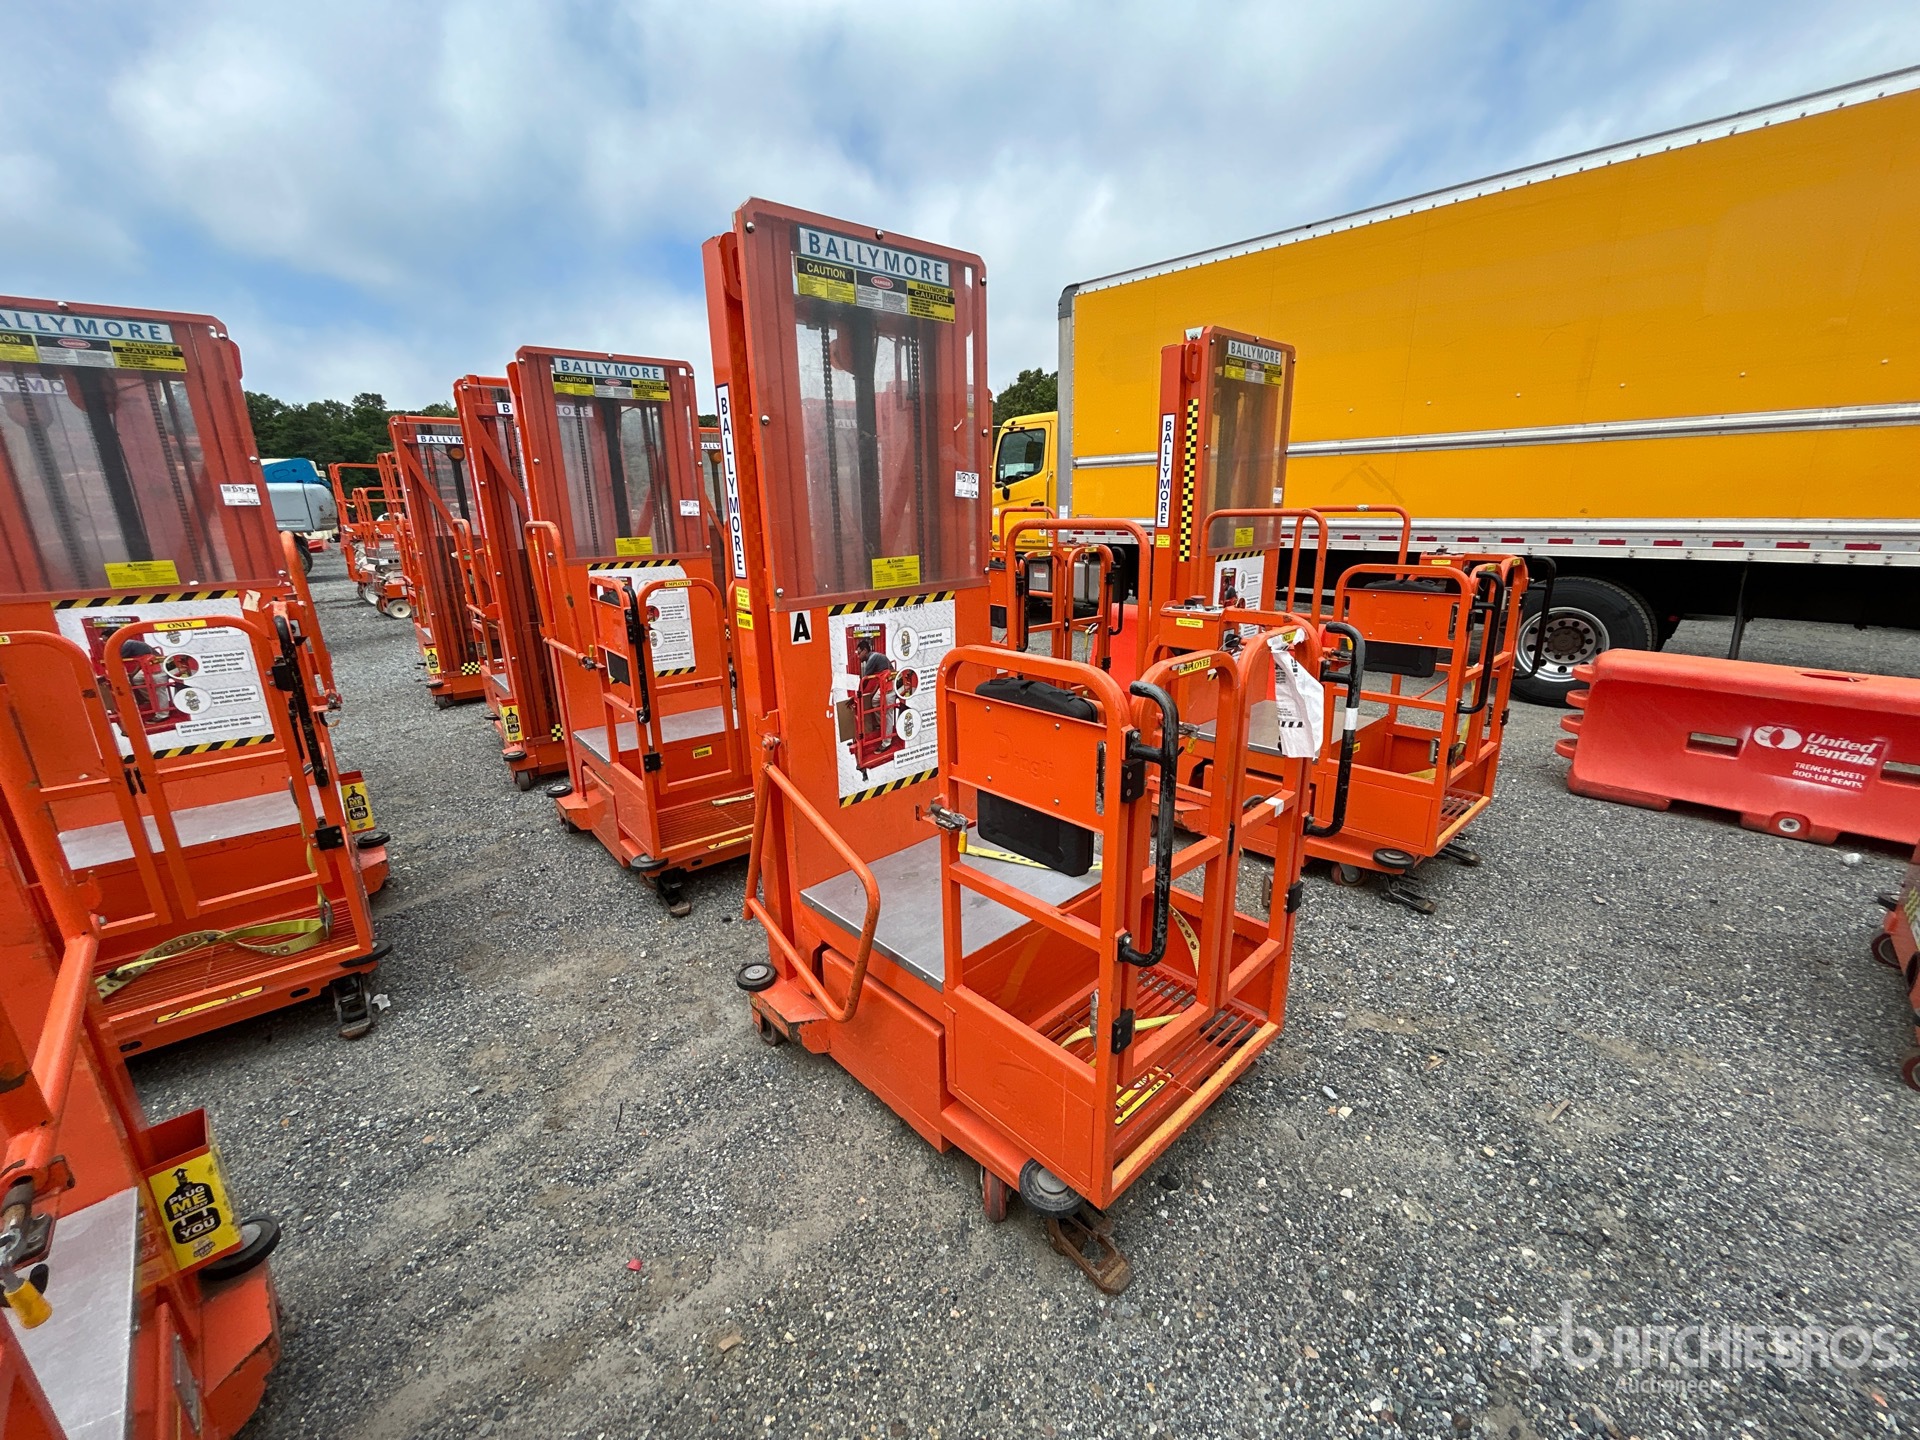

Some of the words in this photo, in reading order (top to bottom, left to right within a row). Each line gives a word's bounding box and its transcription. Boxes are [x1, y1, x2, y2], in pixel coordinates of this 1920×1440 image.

[808, 232, 943, 283] BALLYMORE
[806, 262, 846, 280] CAUTION
[873, 278, 892, 288] DANGER
[917, 283, 946, 295] BALLYMORE
[914, 290, 949, 303] CAUTION
[1231, 342, 1279, 363] BALLYMORE
[561, 360, 659, 379] BALLYMORE
[1160, 420, 1173, 523] BALLYMORE
[720, 397, 744, 571] BALLYMORE
[792, 612, 811, 642] A
[1806, 732, 1878, 754] United
[1801, 743, 1878, 767] Rentals
[1792, 769, 1864, 789] 800-UR-RENTS
[1794, 761, 1831, 774] TRENCH
[1832, 768, 1867, 781] SAFETY
[168, 1185, 205, 1205] PLUG
[170, 1191, 208, 1214] ME
[181, 1217, 215, 1238] YOU
